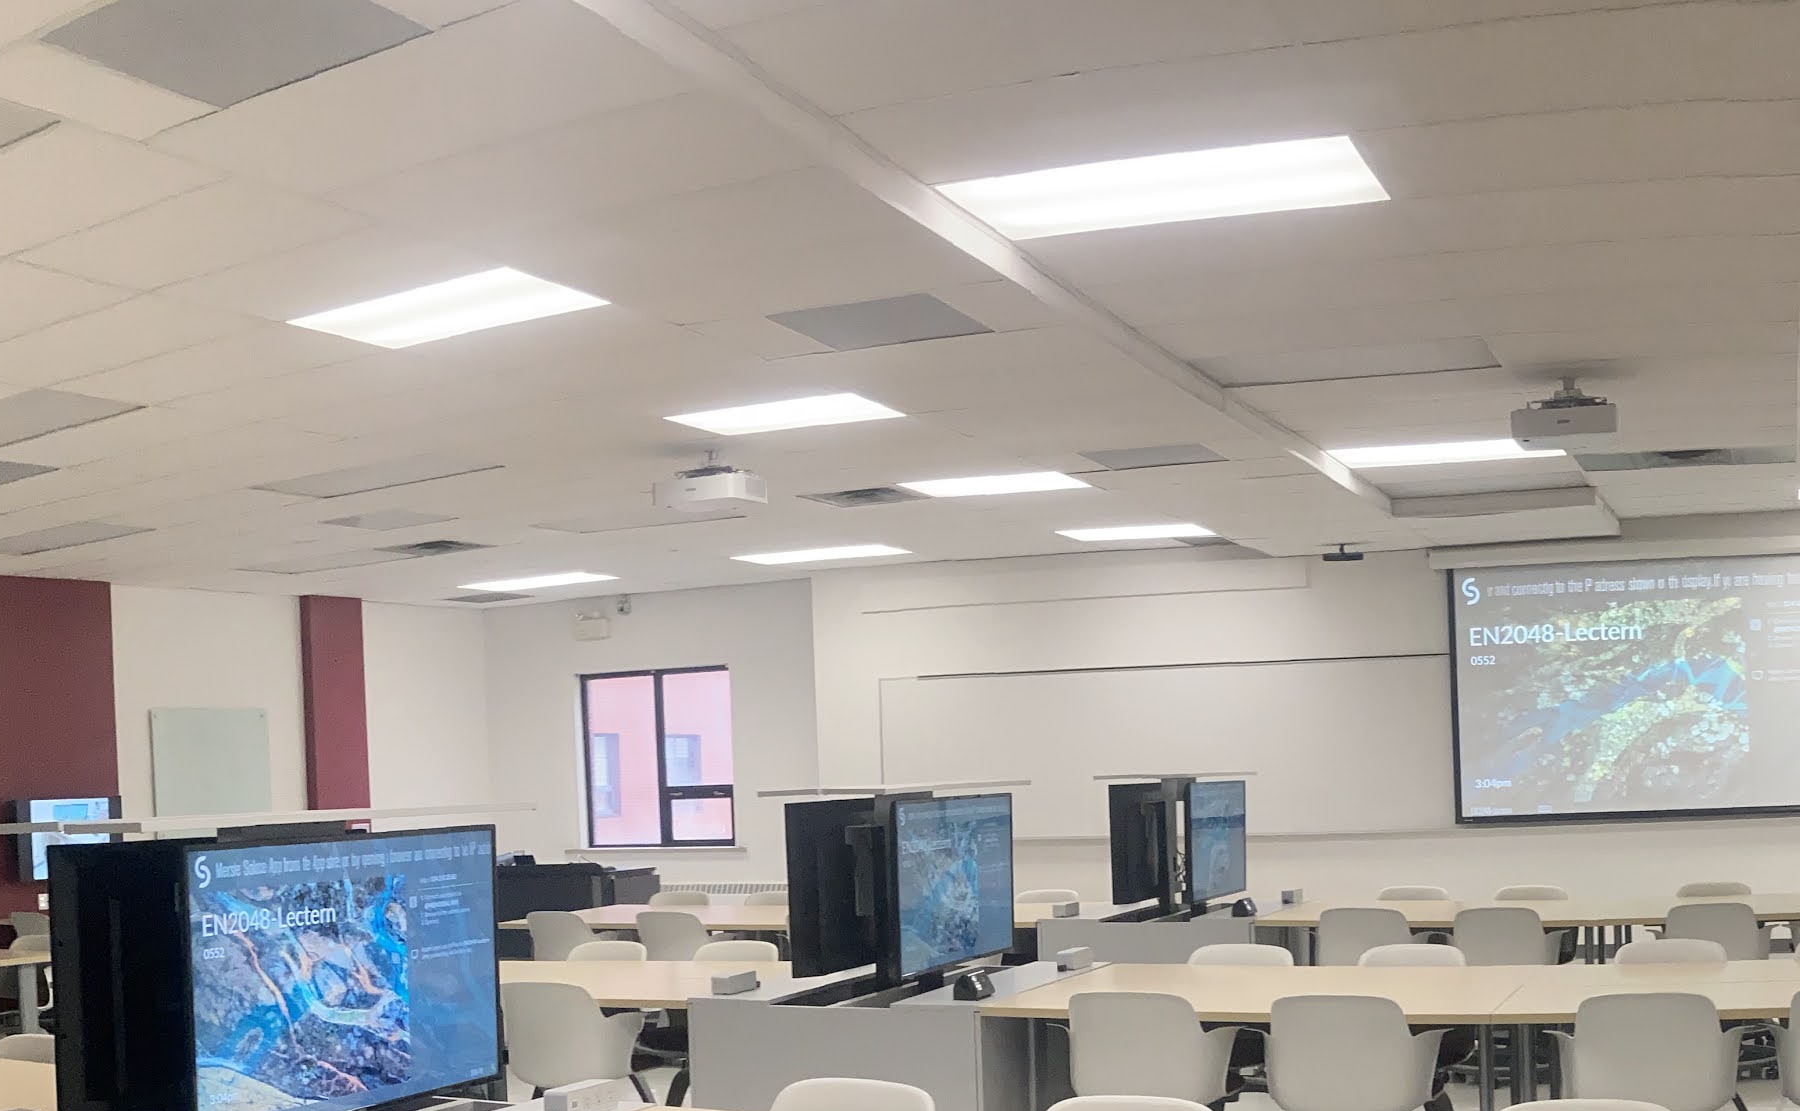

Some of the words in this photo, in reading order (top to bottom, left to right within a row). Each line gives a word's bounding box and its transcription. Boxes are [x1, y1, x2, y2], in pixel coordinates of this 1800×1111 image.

[1469, 622, 1643, 647] EN2048-Lectern
[1470, 655, 1496, 666] 0552
[202, 905, 336, 937] EN2048-Lectern
[203, 947, 225, 960] 0552
